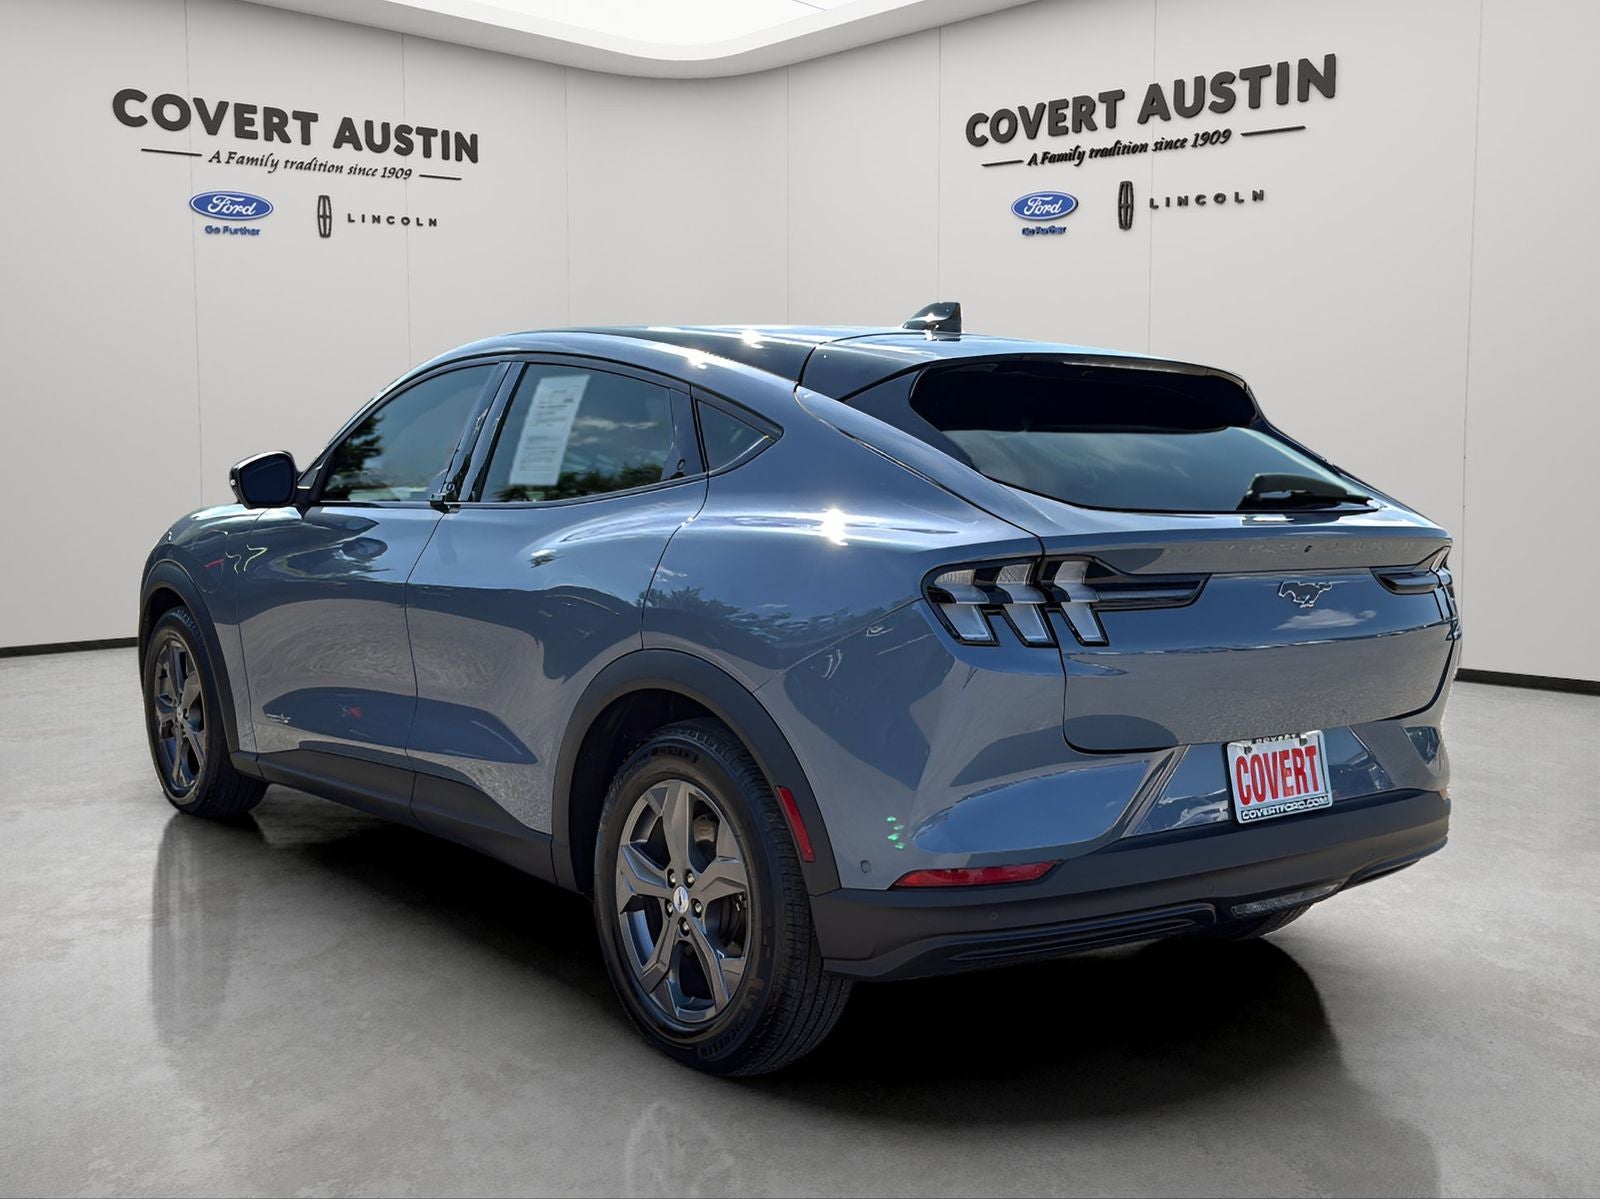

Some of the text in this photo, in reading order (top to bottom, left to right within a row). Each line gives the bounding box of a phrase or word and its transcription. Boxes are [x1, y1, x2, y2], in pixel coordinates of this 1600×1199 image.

[965, 53, 1337, 148] COVERT AUSTIN
[112, 88, 479, 163] COVERT AUSTIN
[1027, 128, 1232, 167] A Family tradition since 1909
[208, 149, 413, 181] A Family tradition since 1909
[207, 195, 257, 215] Ford
[1023, 196, 1063, 215] Ford
[1149, 188, 1266, 210] LINCOLN
[347, 213, 438, 227] LINCOLN
[1236, 745, 1319, 806] COVERT
[1242, 796, 1328, 819] COVERTFORD.COM
